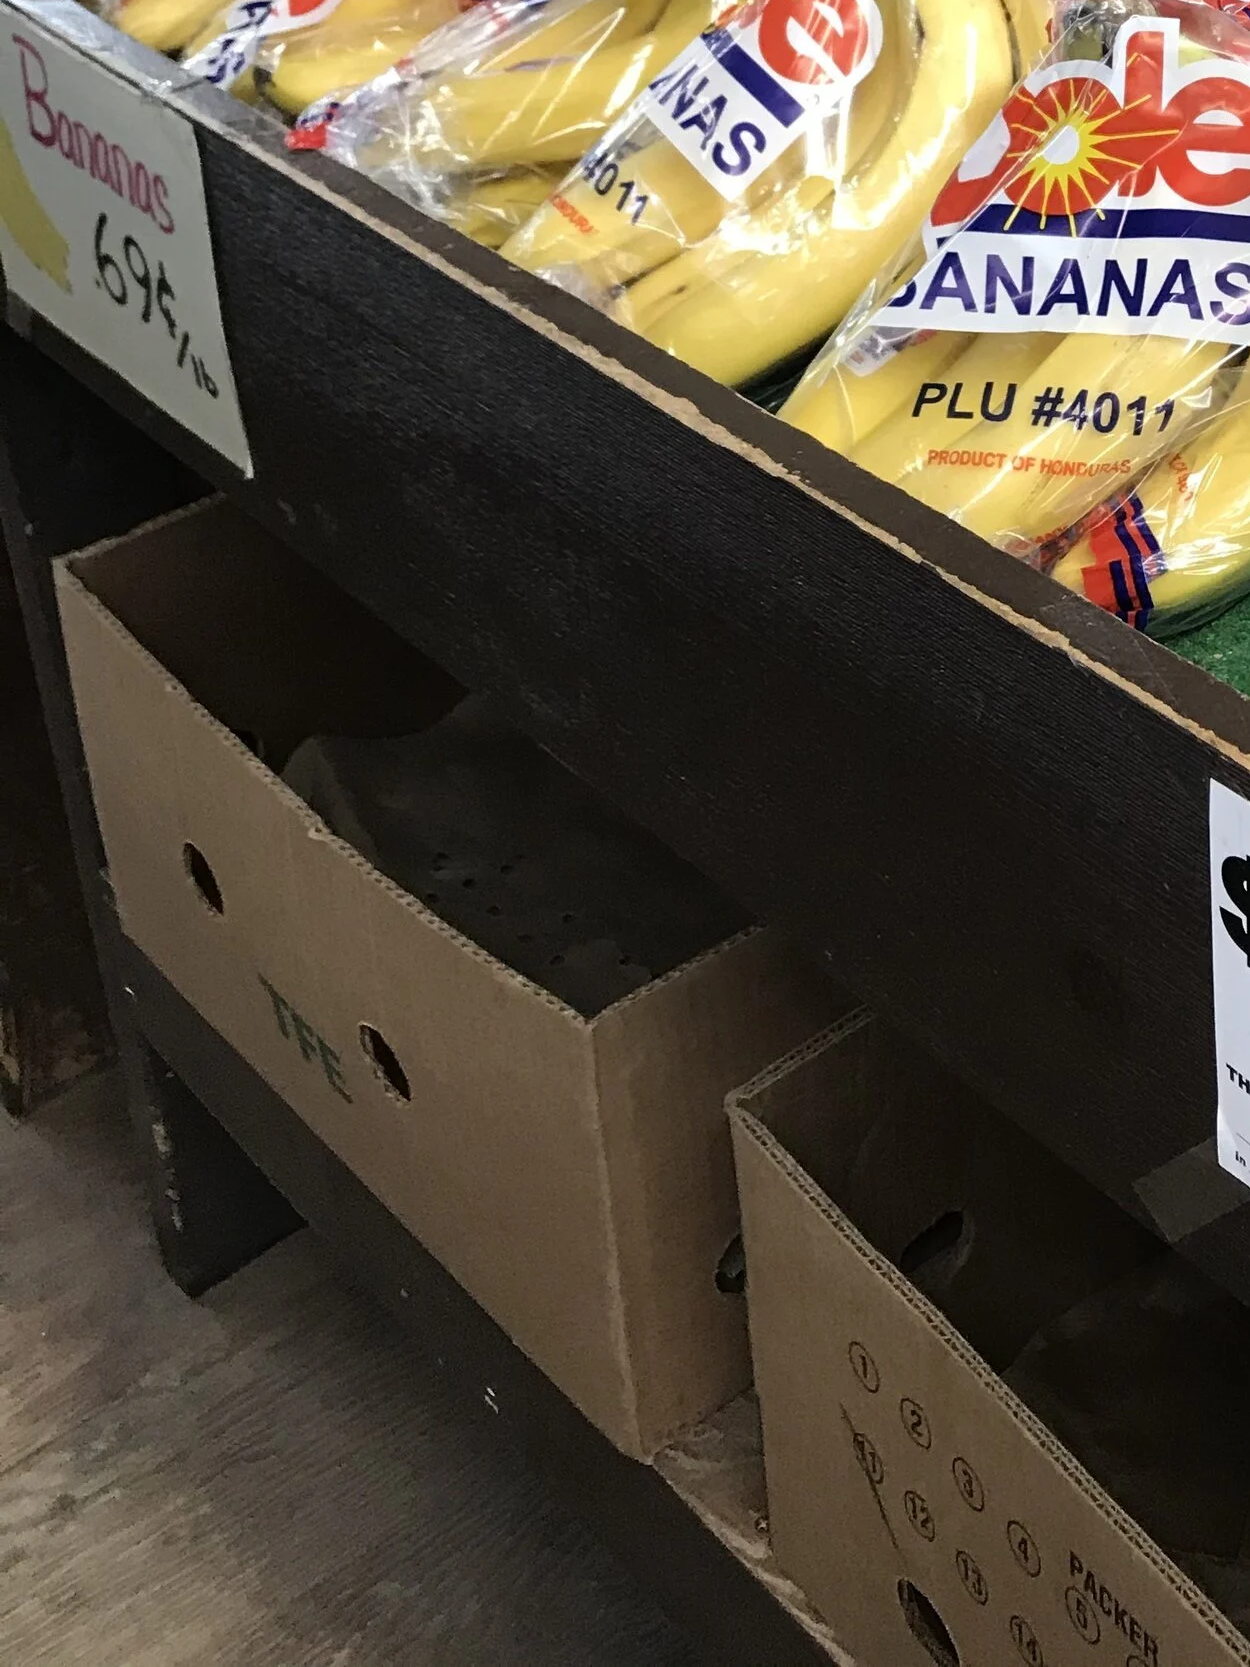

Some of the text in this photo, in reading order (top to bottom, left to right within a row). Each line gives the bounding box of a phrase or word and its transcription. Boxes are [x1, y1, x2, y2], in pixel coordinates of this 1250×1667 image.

[12, 34, 175, 234] Bananas
[911, 381, 1175, 436] PLU #4011
[927, 449, 1008, 469] PRODUCT
[1011, 456, 1036, 473] OF
[1235, 1150, 1247, 1168] in
